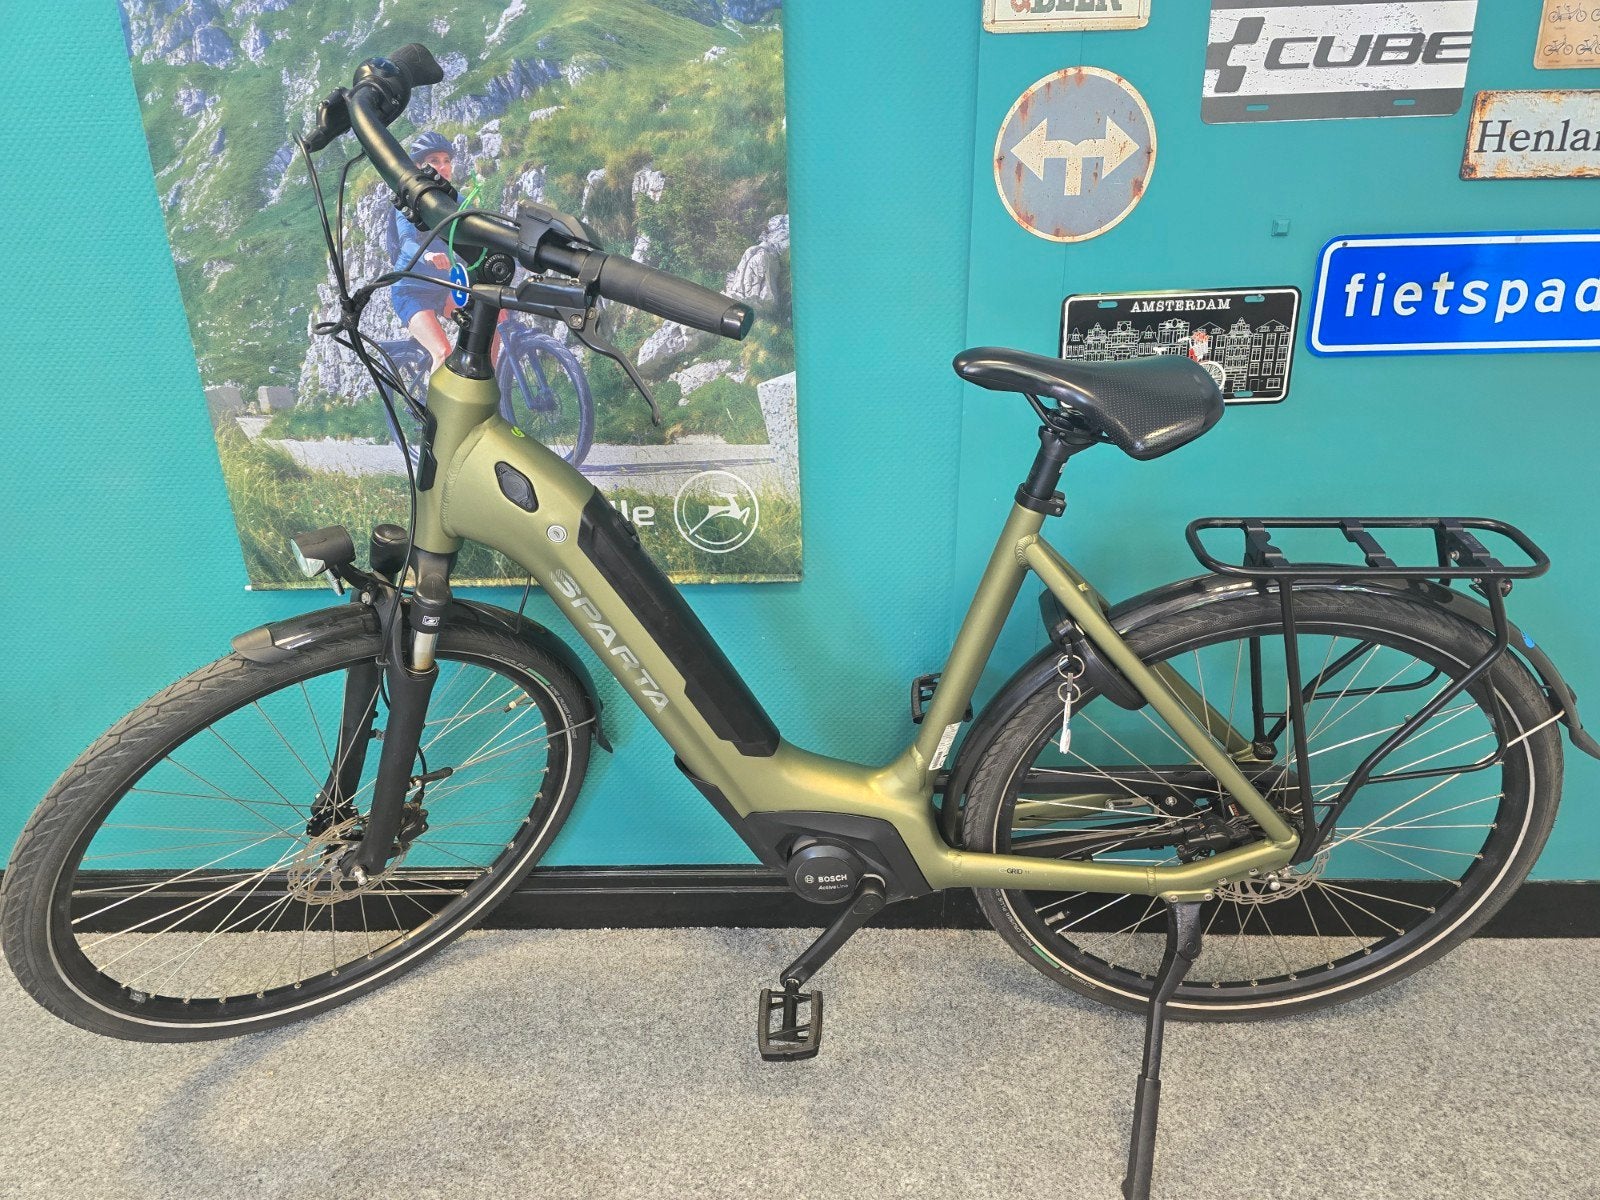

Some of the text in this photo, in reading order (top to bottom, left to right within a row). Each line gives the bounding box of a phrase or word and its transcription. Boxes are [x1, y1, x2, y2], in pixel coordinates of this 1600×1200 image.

[1264, 31, 1473, 70] CUBE
[1130, 298, 1231, 313] AMSTERDAM
[550, 568, 670, 714] SPARTA
[817, 873, 848, 883] BOSCH
